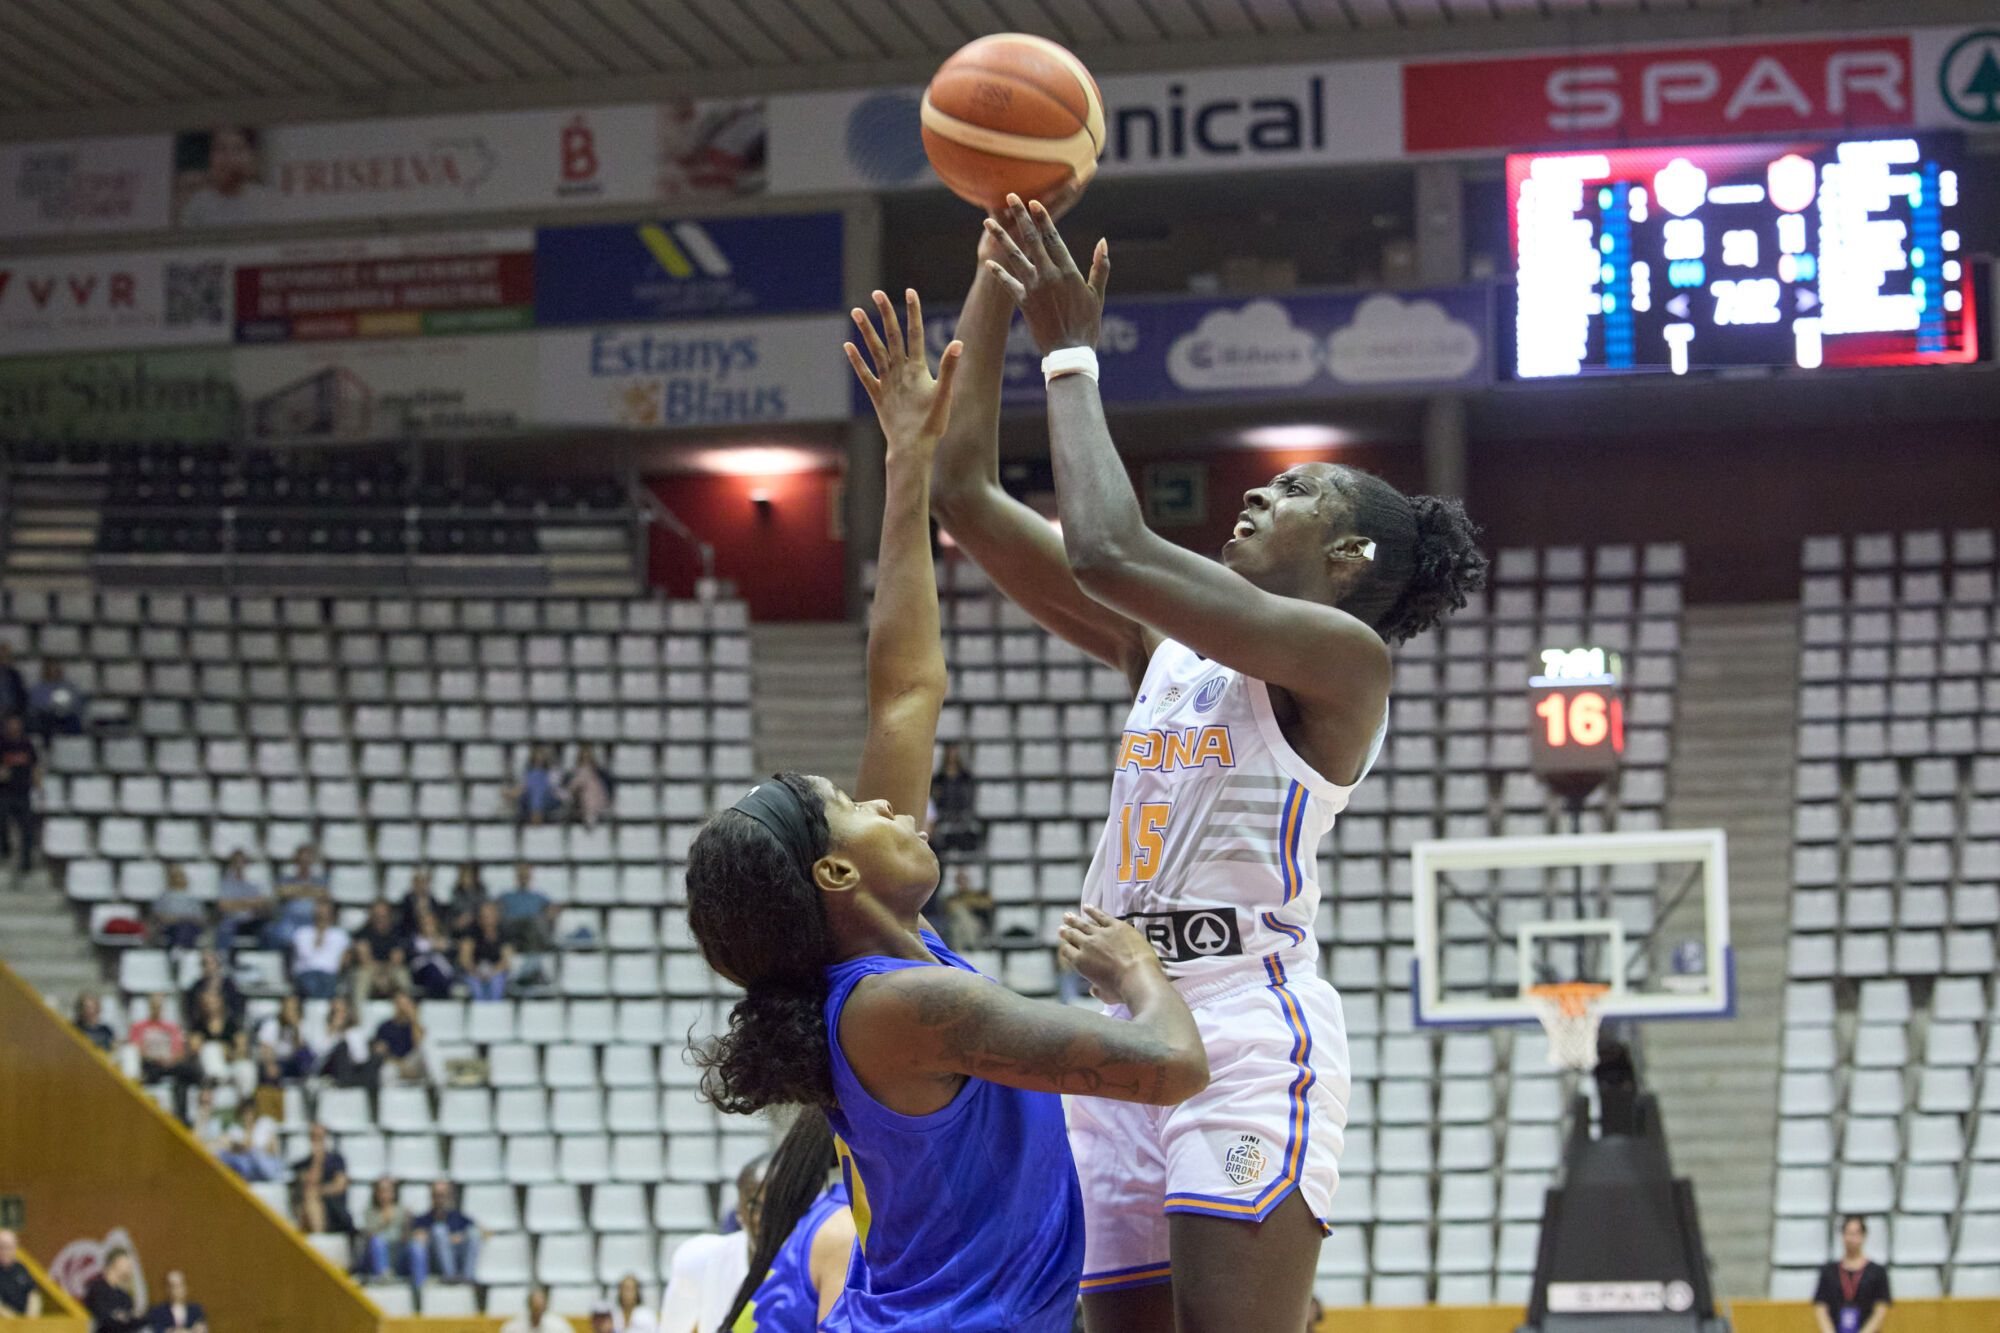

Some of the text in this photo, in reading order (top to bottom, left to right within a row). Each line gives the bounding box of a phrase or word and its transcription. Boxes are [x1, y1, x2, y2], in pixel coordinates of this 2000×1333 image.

[1545, 50, 1905, 130] SPAR
[1098, 76, 1325, 163] nical
[589, 330, 759, 379] Estanys
[663, 378, 786, 426] Blaus
[1536, 691, 1608, 748] 16
[1117, 802, 1172, 883] 15
[1232, 1155, 1261, 1168] BASQUET
[1241, 1135, 1260, 1145] UNI
[1225, 1162, 1259, 1180] GIRONA
